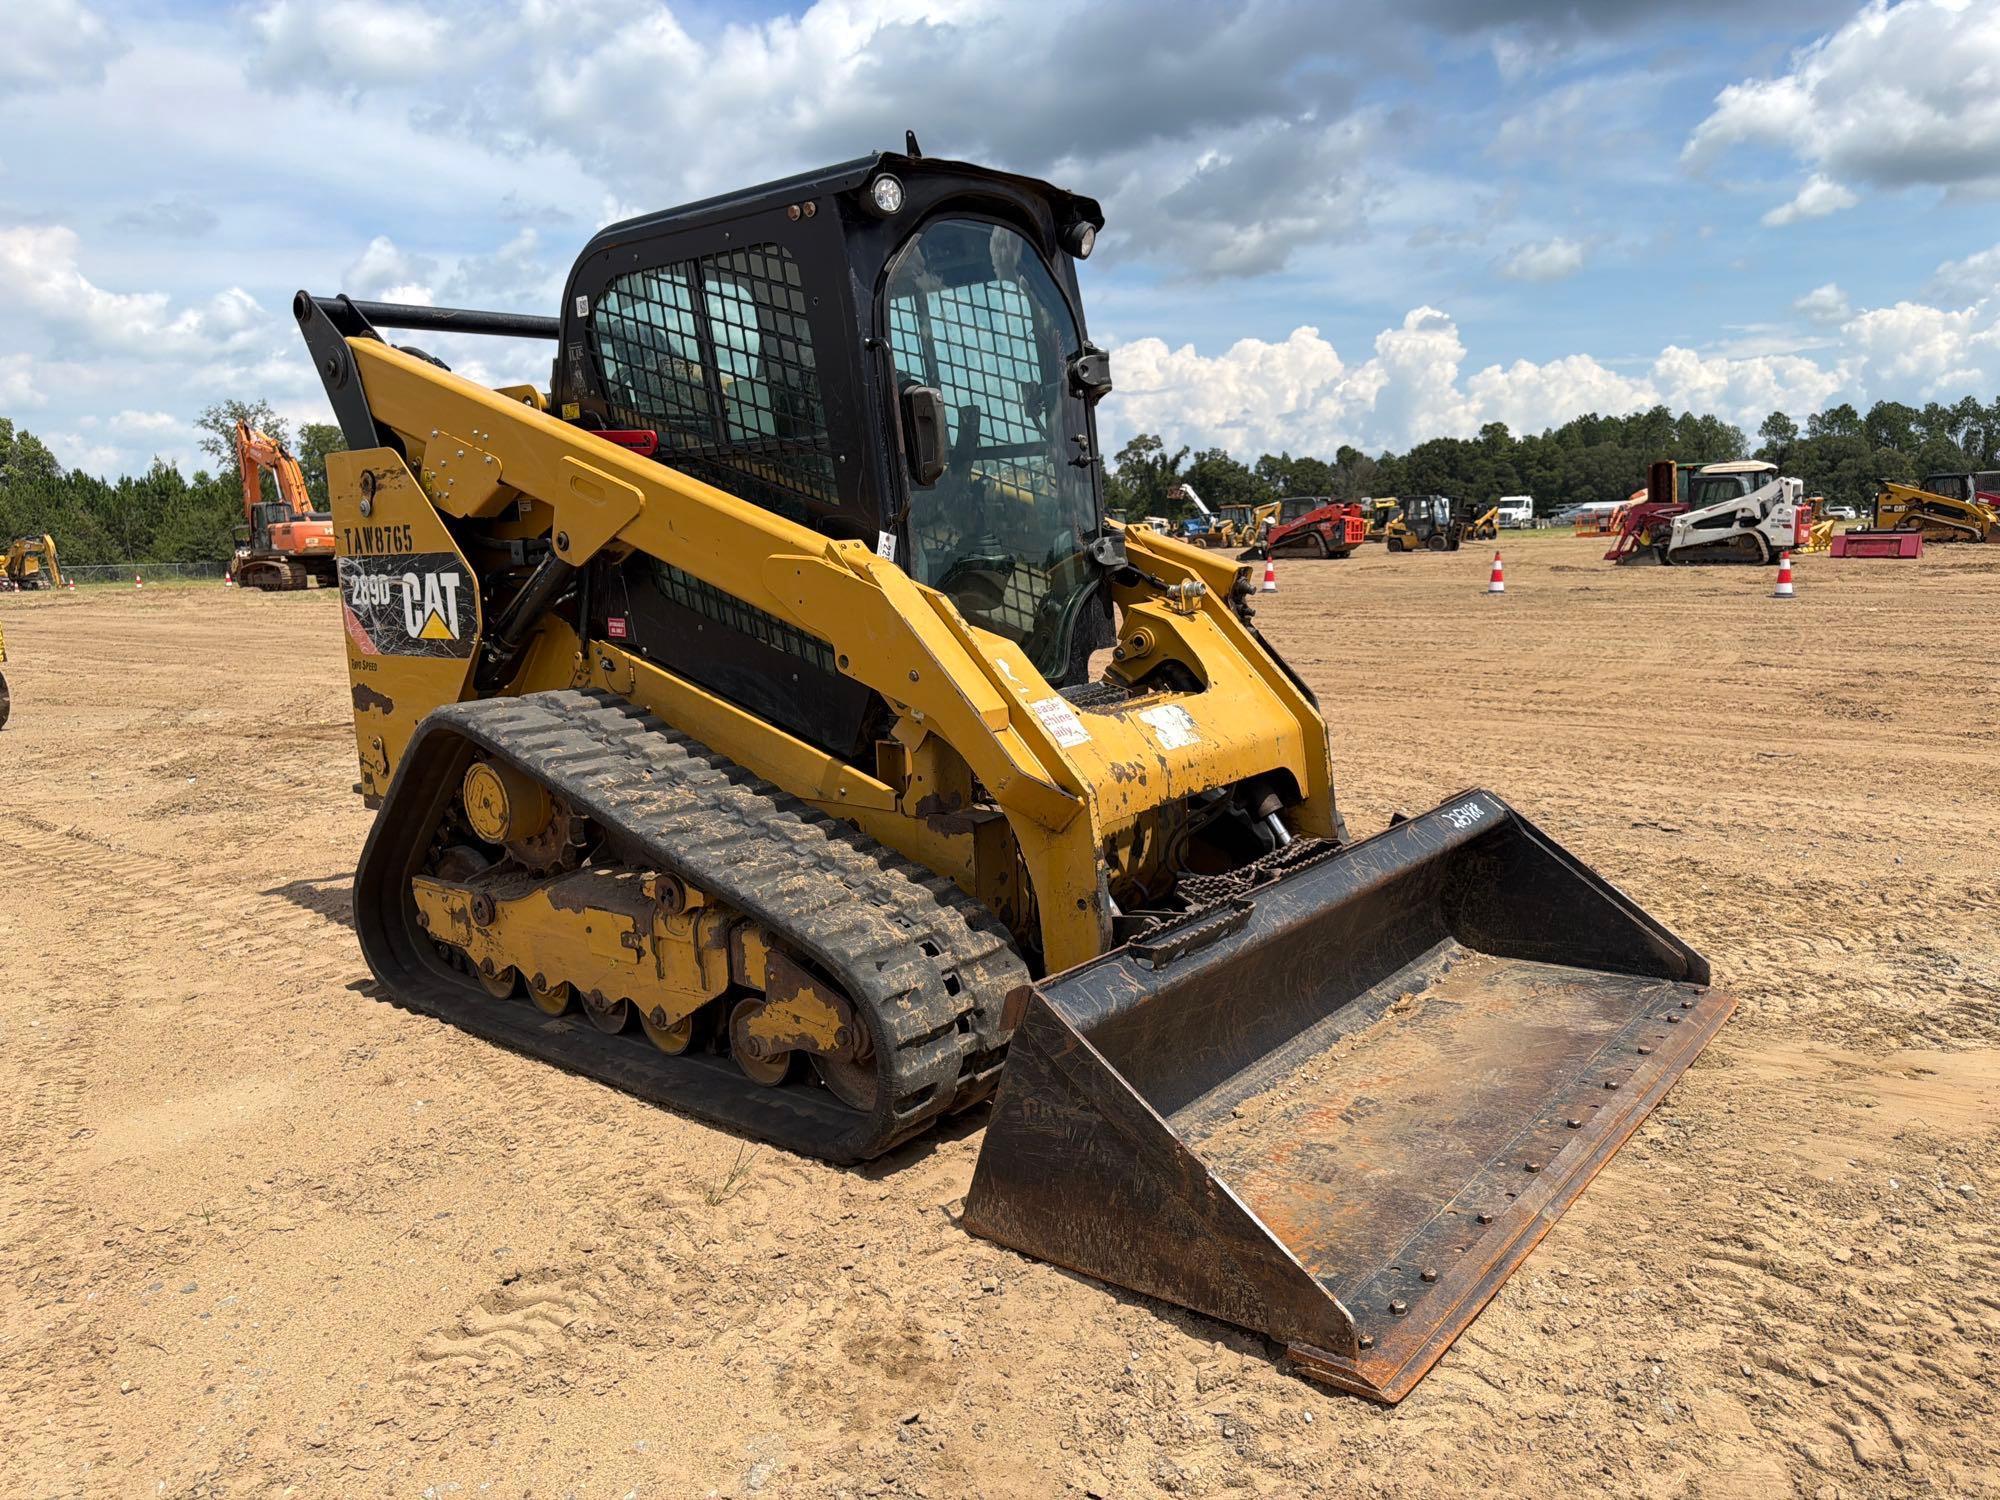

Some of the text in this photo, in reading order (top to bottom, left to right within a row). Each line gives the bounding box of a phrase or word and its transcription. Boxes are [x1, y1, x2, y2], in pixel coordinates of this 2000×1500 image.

[344, 524, 413, 554] TAW8765
[351, 571, 461, 640] 289D CAT
